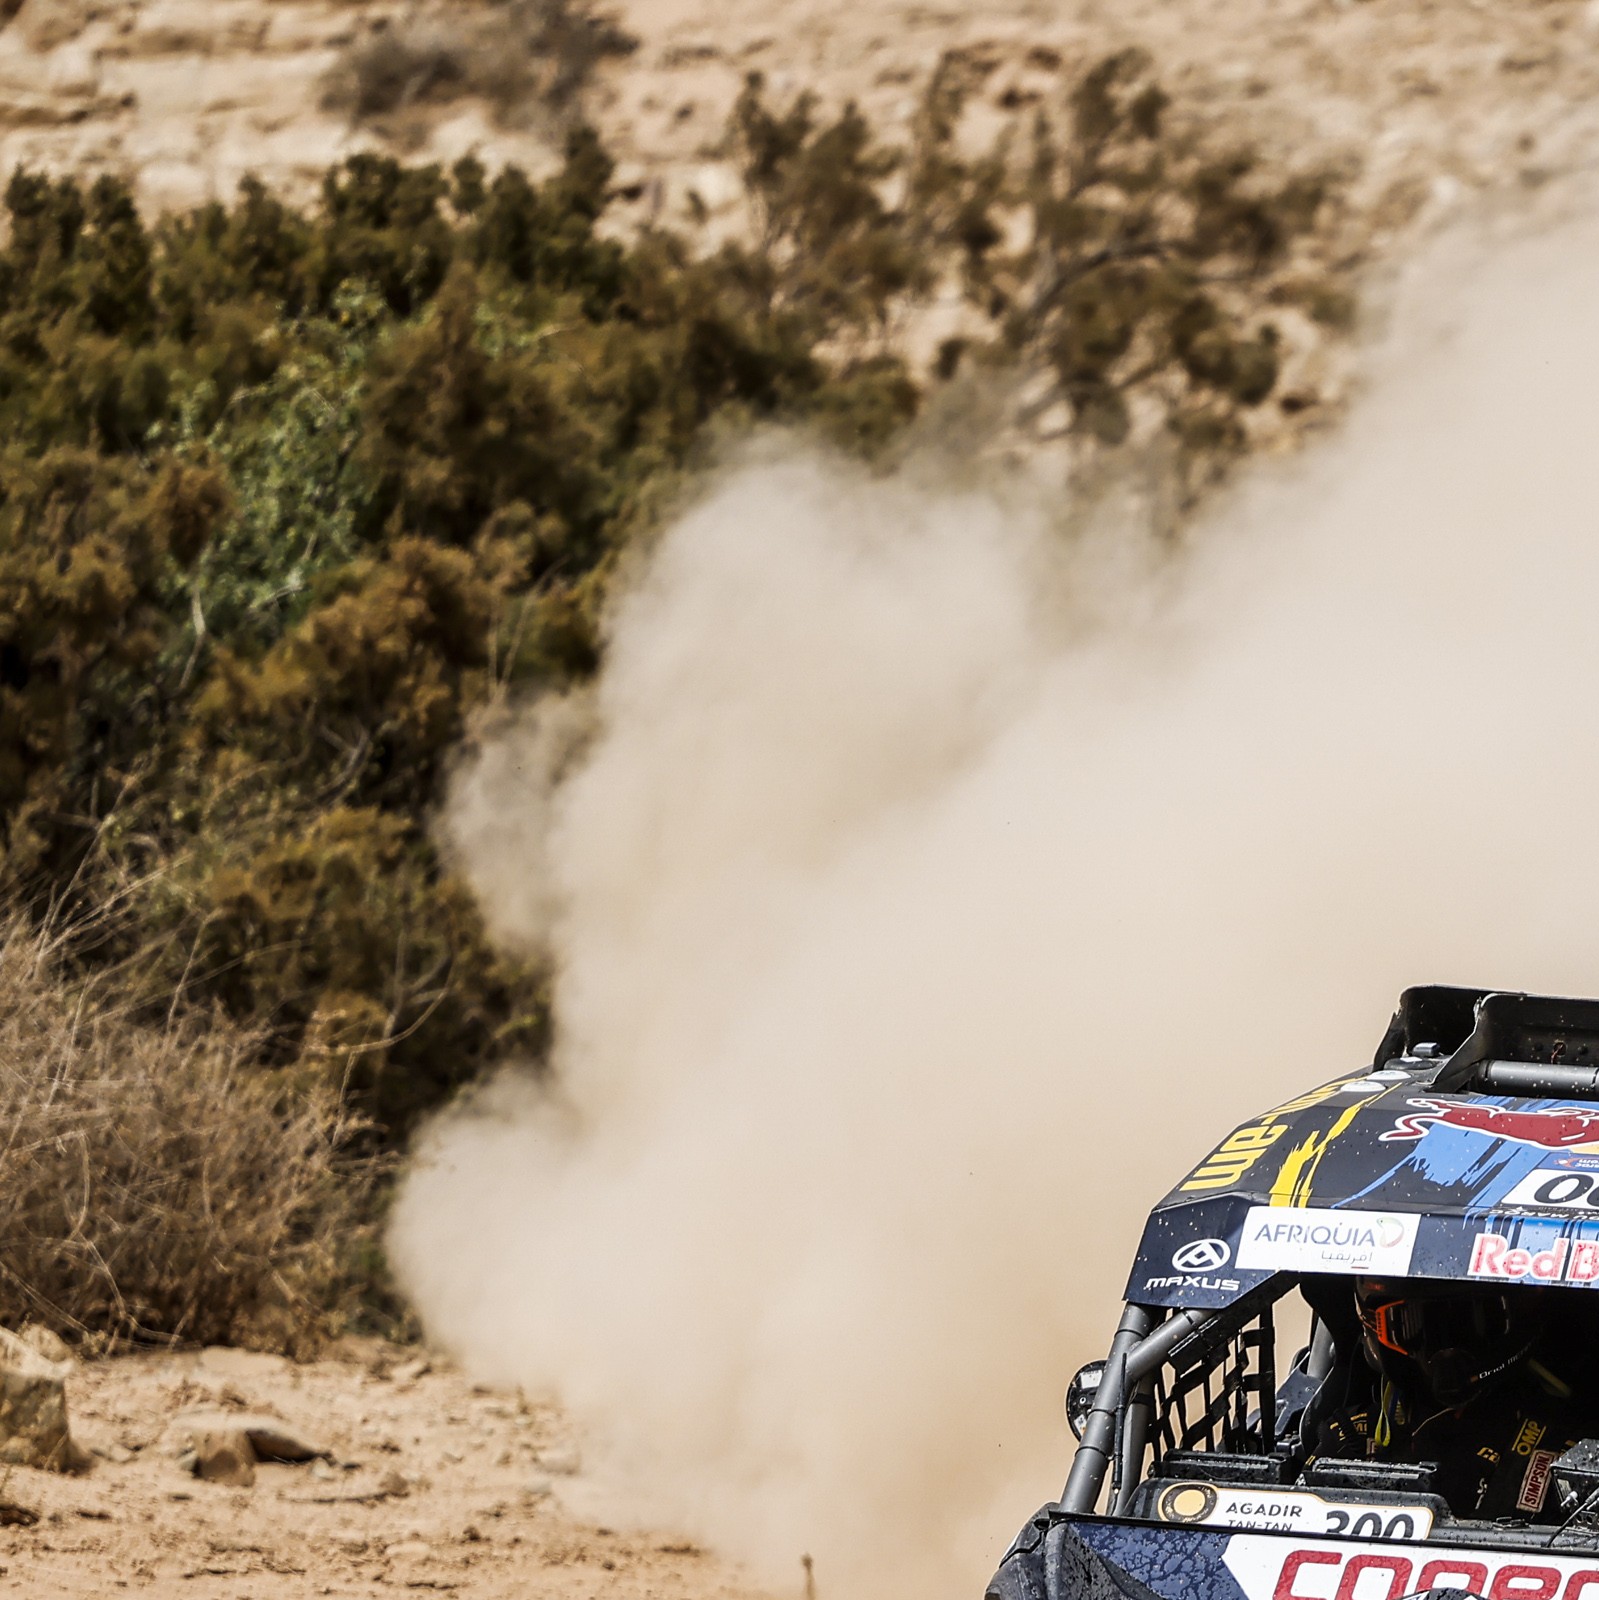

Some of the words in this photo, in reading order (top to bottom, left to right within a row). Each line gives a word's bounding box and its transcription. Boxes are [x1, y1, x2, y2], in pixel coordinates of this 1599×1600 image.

[1254, 1223, 1375, 1247] AFRIQUIA
[1469, 1233, 1568, 1280] Red
[1145, 1276, 1240, 1291] MAXUS
[1515, 1420, 1542, 1456] OMP
[1524, 1455, 1551, 1506] SIMPSON
[1225, 1502, 1303, 1517] AGADIR
[1228, 1519, 1293, 1531] TAN-TAN
